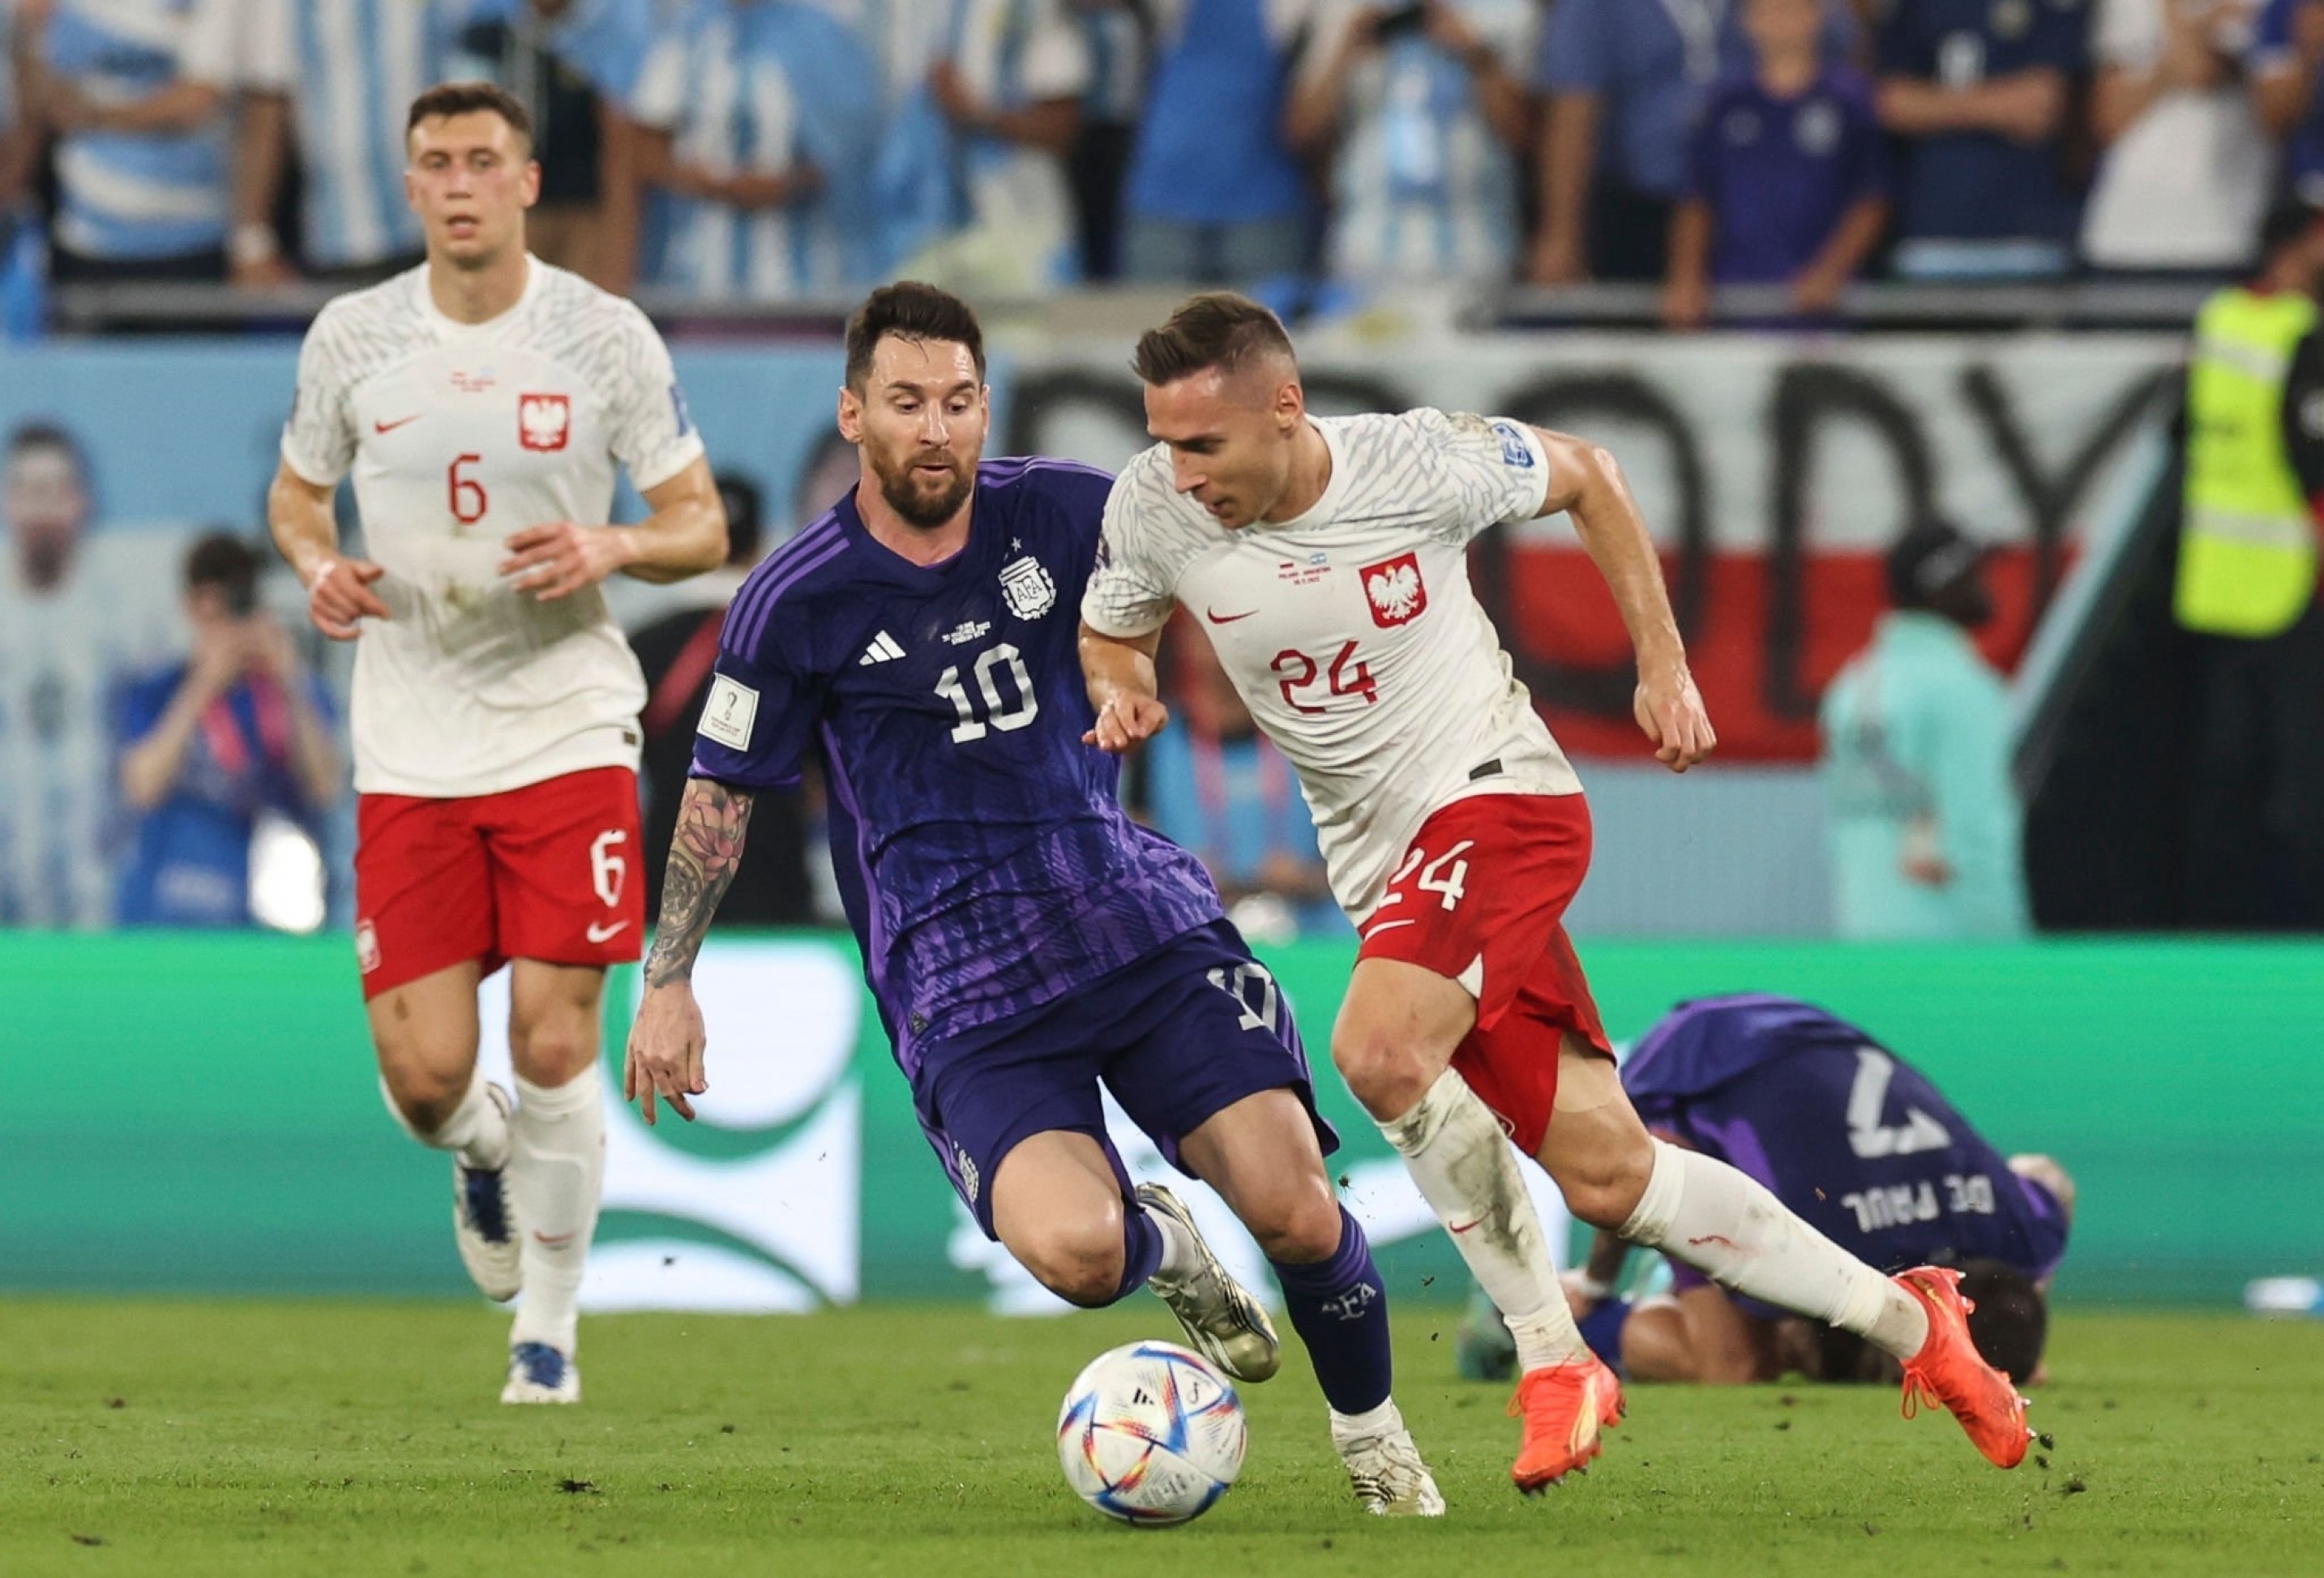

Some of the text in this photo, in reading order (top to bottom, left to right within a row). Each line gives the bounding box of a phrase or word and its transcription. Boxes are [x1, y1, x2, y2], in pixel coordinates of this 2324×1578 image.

[447, 452, 488, 524] 6
[1013, 575, 1043, 602] AFA
[934, 643, 1038, 744] 10
[1270, 640, 1377, 714] 24
[589, 829, 627, 908] 6
[1846, 1046, 1950, 1158] 7
[1841, 1174, 1995, 1234] DE PAUL
